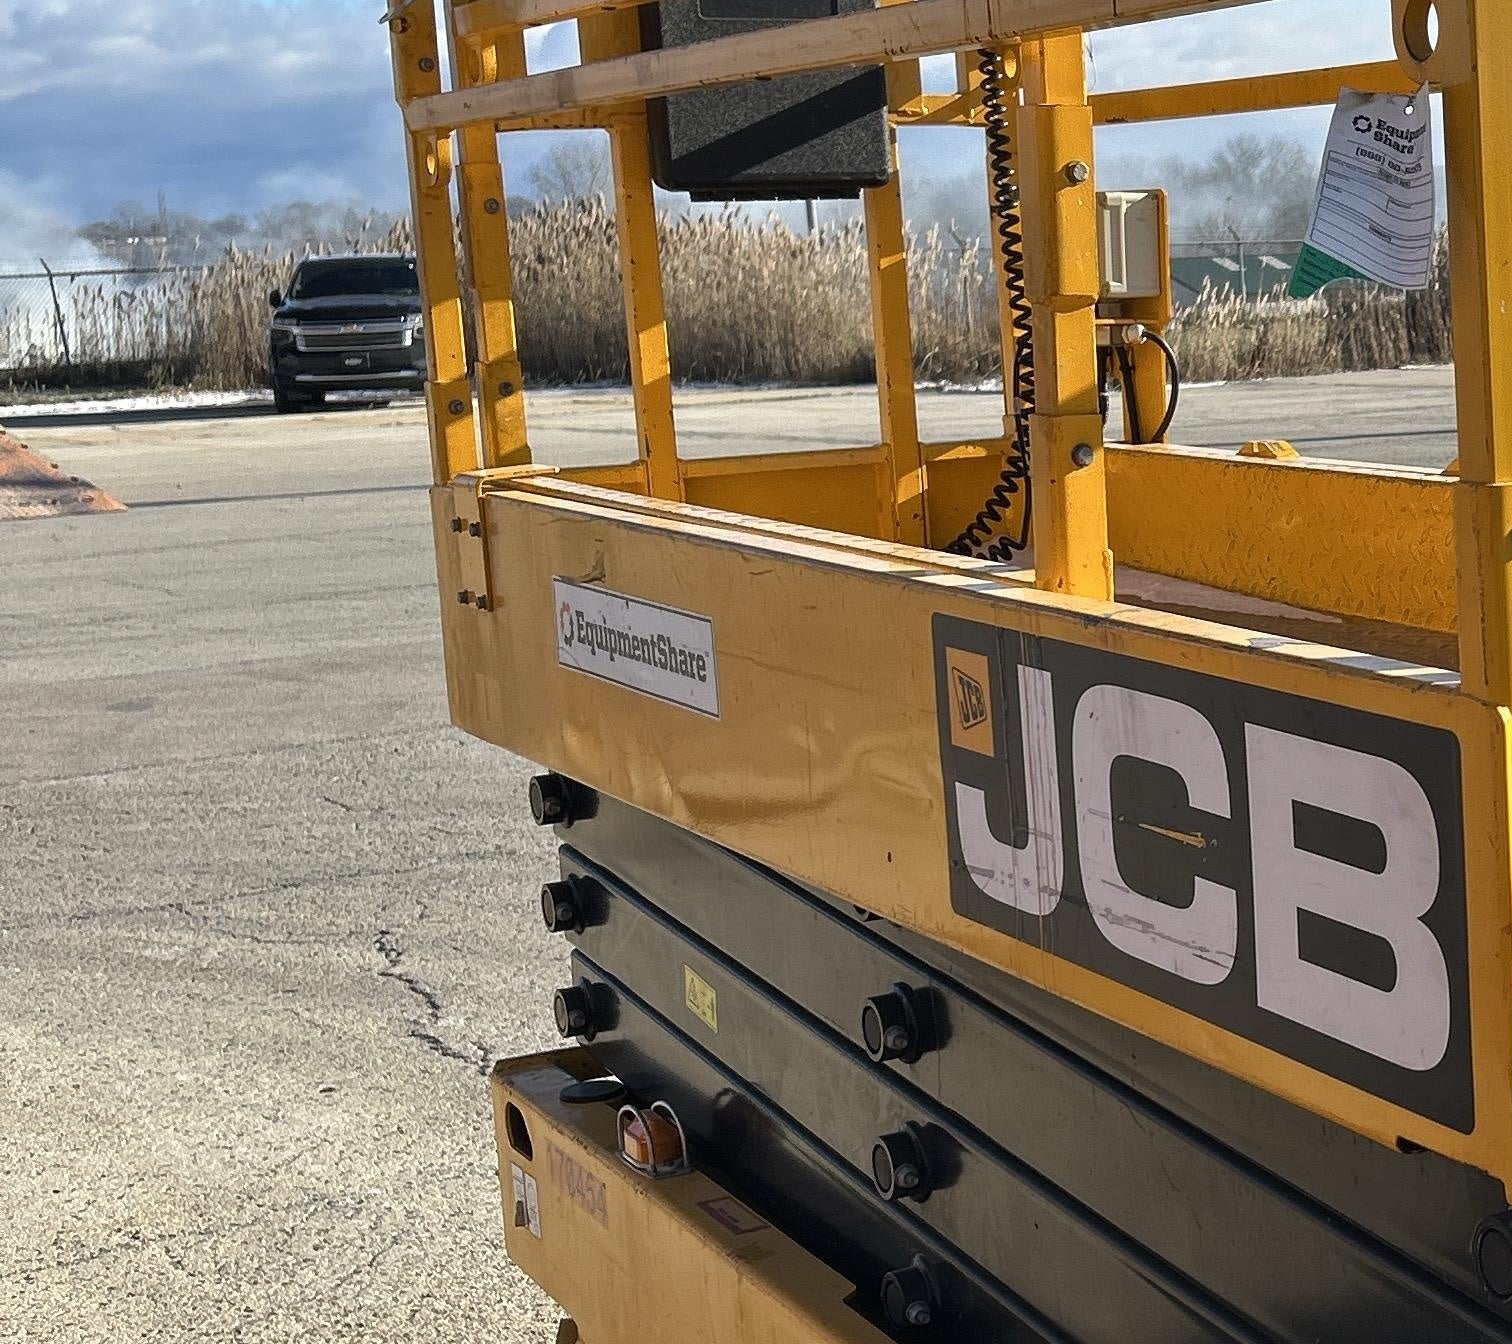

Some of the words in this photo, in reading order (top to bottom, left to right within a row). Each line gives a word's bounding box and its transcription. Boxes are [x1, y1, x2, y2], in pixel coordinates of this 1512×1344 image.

[1374, 130, 1415, 154] Share
[574, 609, 707, 683] EquipmentShare
[956, 674, 986, 725] JCB
[955, 666, 1451, 1072] JCB
